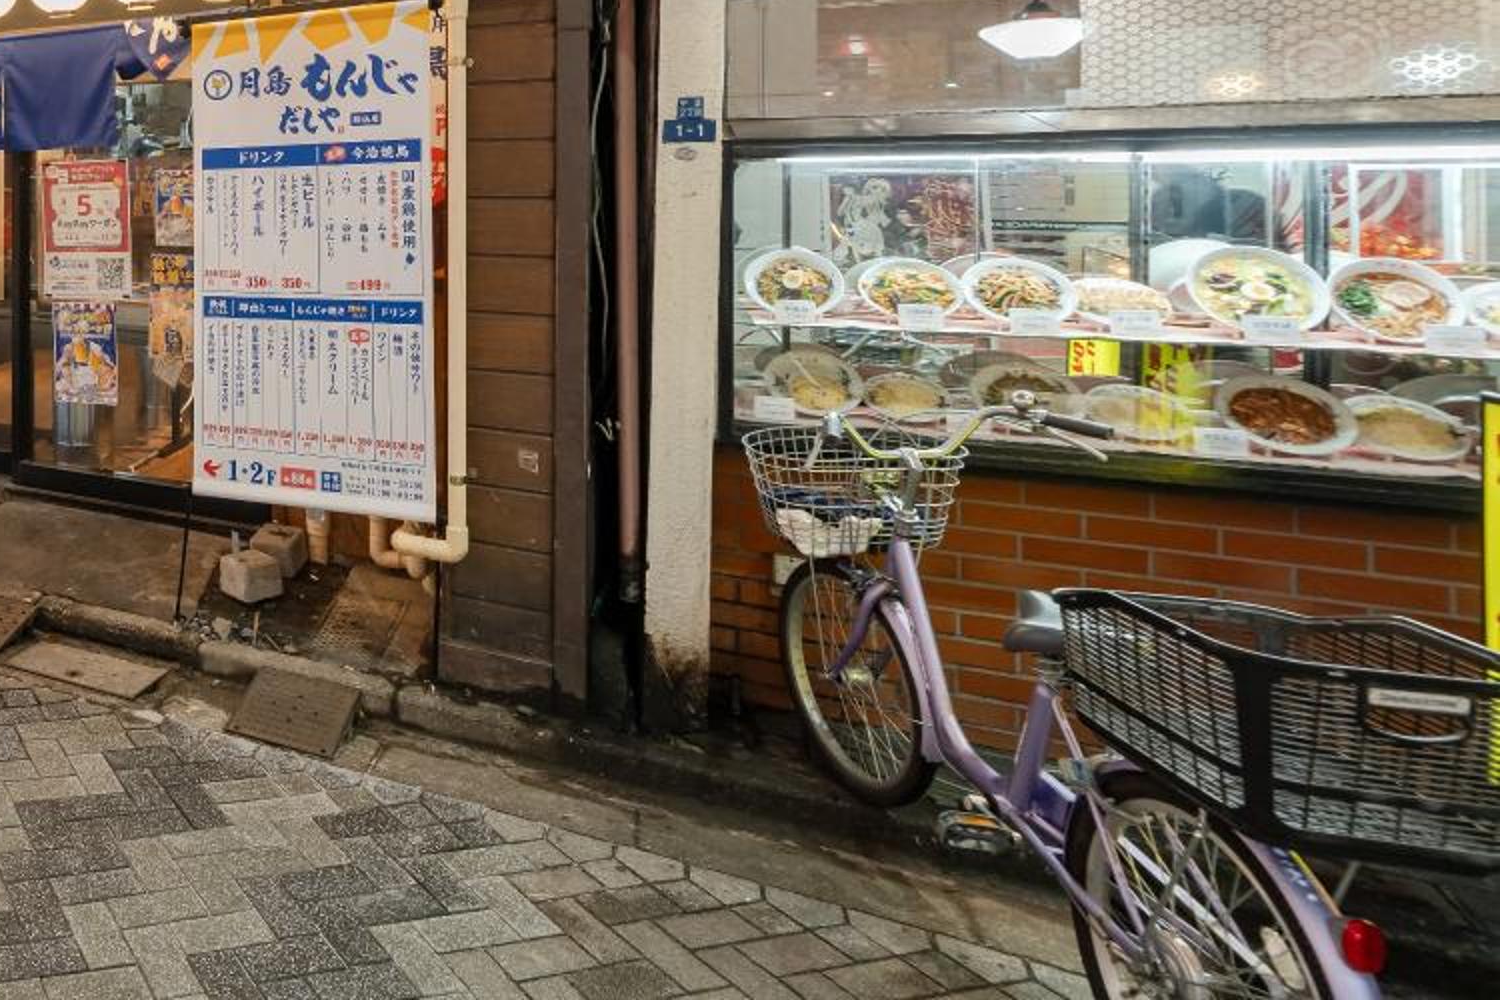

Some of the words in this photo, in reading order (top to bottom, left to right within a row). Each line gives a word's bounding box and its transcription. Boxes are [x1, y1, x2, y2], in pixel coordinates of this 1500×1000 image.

[239, 66, 292, 98] 月島
[301, 52, 418, 101] もんじゃ
[279, 105, 341, 135] だしや
[676, 123, 704, 137] 1-1
